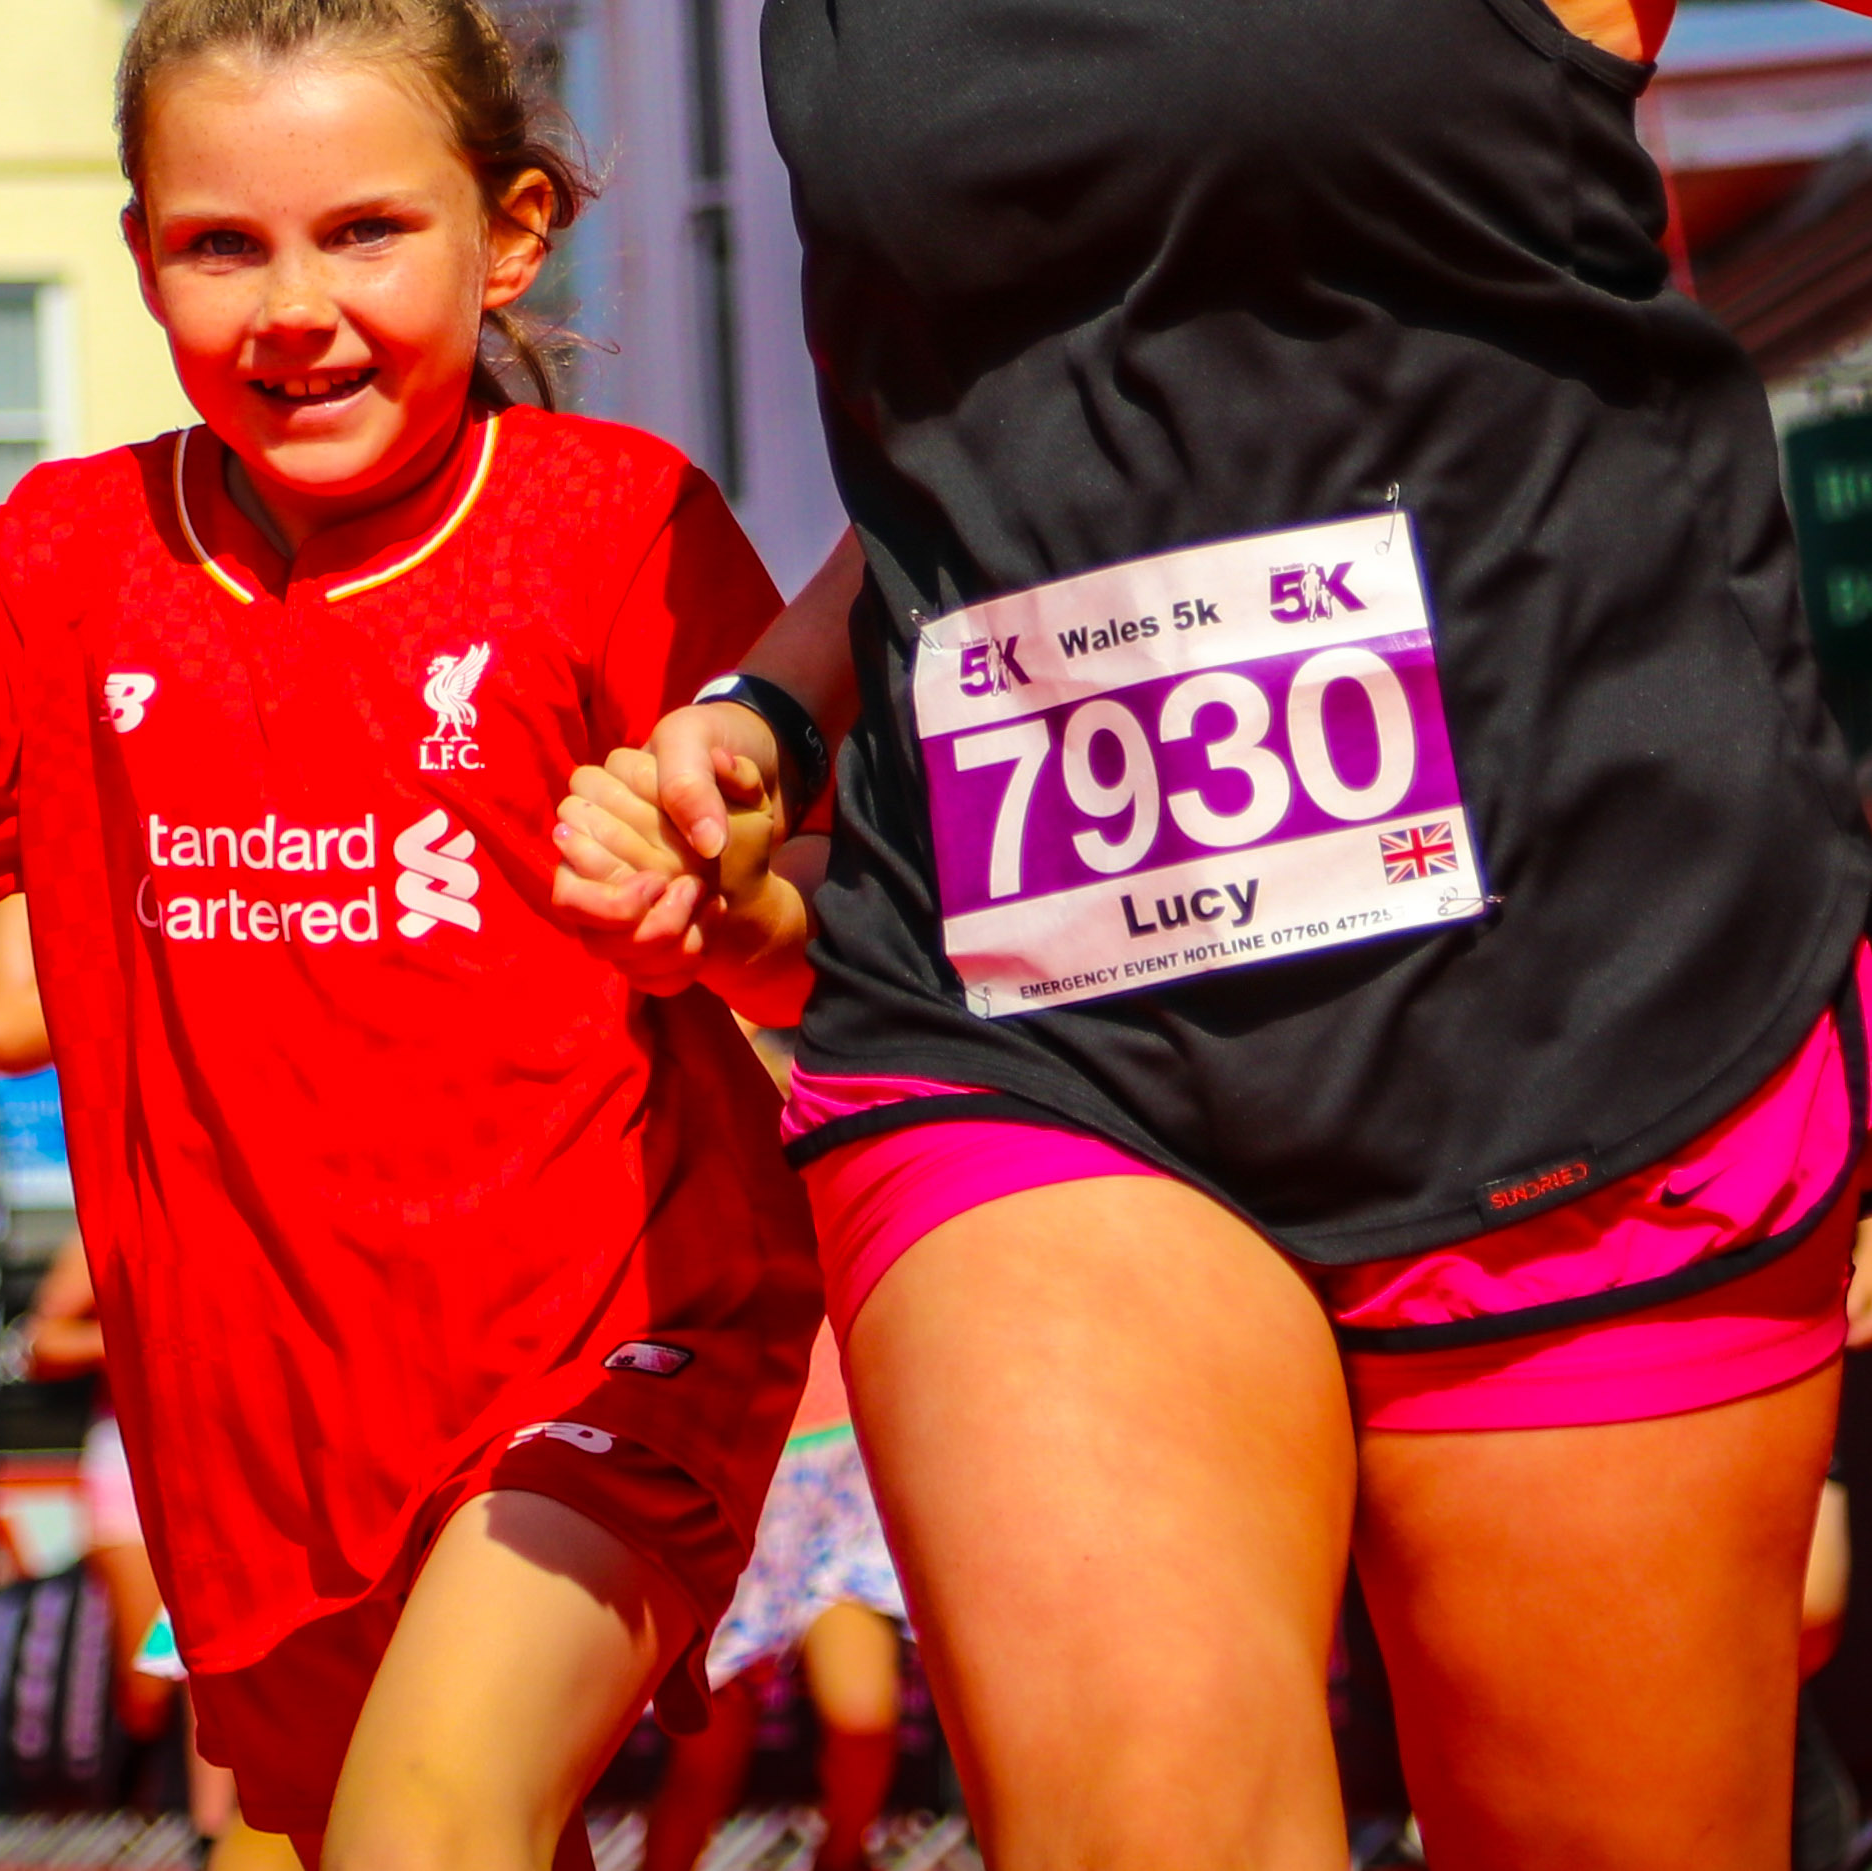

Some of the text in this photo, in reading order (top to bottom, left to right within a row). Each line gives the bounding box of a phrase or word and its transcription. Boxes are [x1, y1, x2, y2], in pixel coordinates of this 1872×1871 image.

[1057, 597, 1223, 660] Wales 5k
[953, 647, 1417, 901] 7930
[147, 812, 376, 872] tandard
[135, 874, 380, 945] Cartered
[1120, 878, 1260, 939] Lucy
[1019, 905, 1406, 1000] EMERGENCY EVENT HOTLINE 07760 47725
